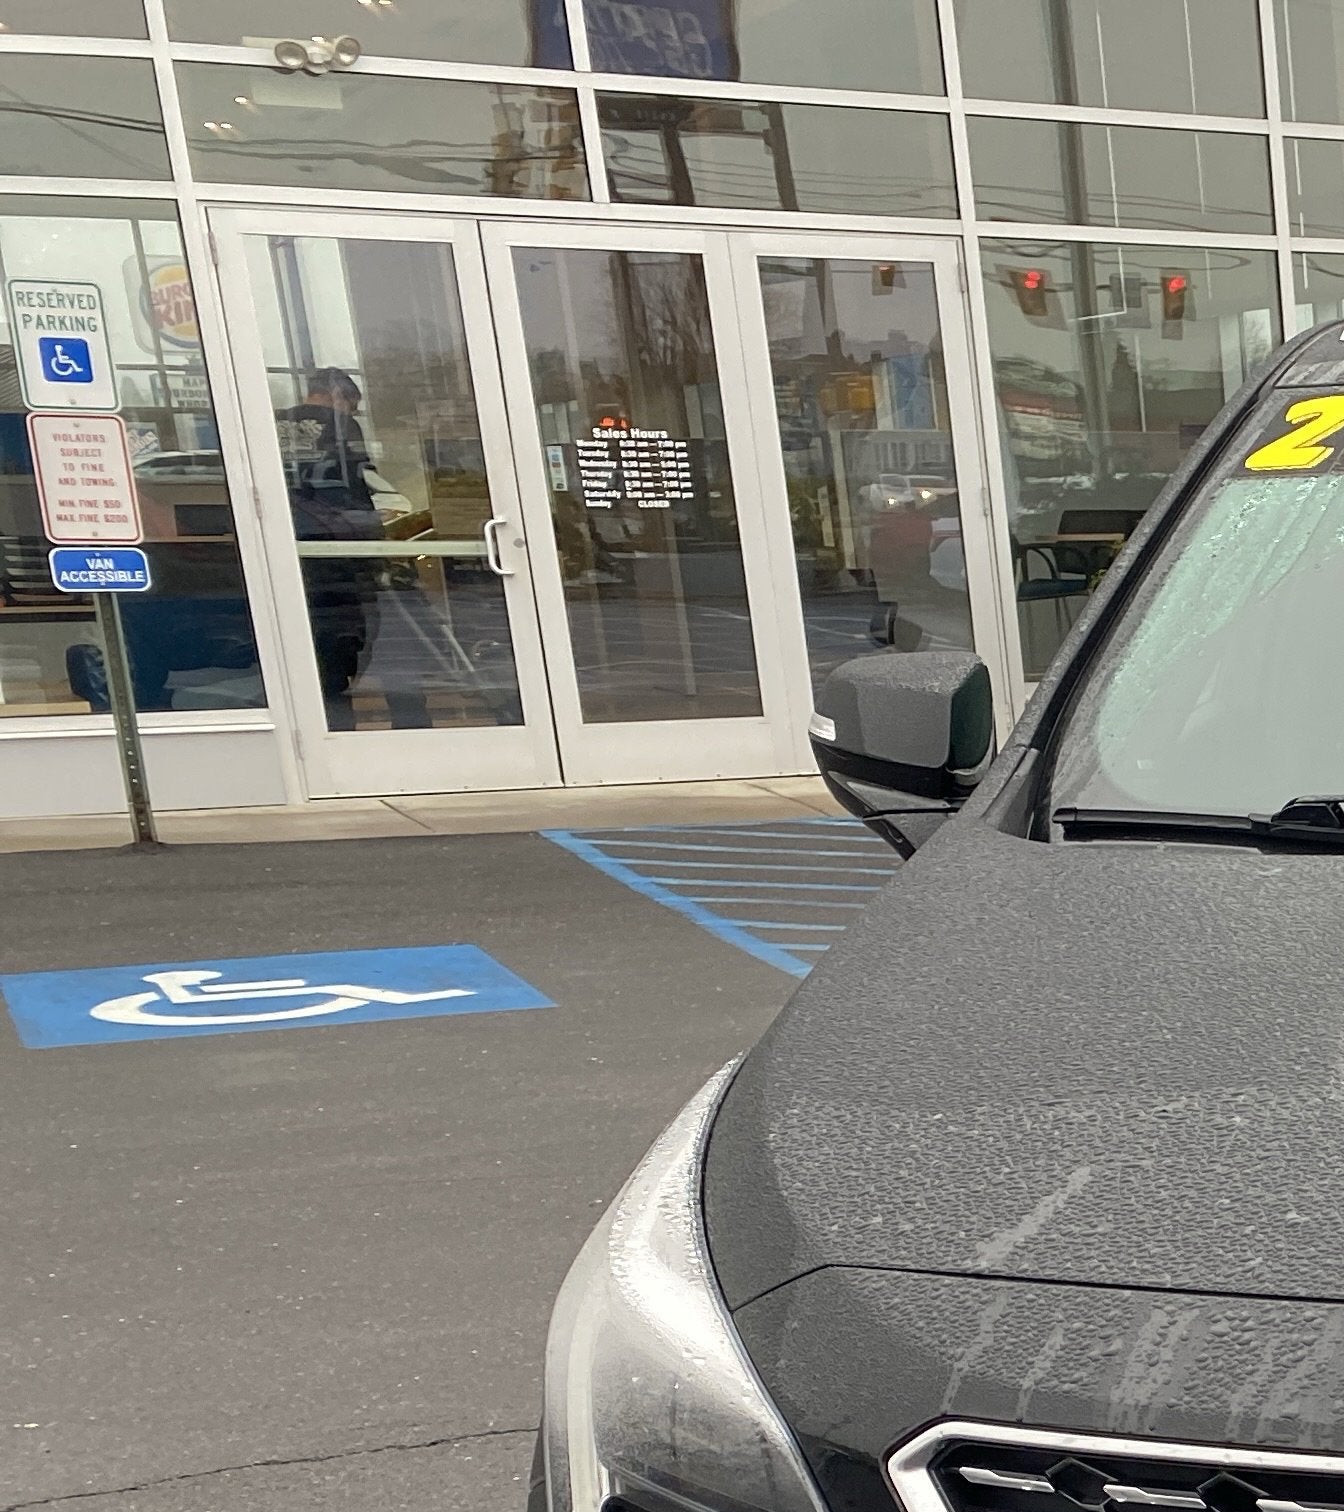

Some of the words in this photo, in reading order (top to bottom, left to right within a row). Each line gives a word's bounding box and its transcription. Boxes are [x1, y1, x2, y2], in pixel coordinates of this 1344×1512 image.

[15, 290, 97, 310] RESERVED
[22, 313, 98, 332] PARKING
[52, 432, 106, 443] VIOLATORS
[592, 427, 628, 439] Sales
[630, 428, 668, 439] Hours
[60, 448, 102, 458] SUBJECT
[63, 462, 75, 472] TO
[81, 462, 105, 473] FINE
[58, 477, 76, 486] AND
[79, 499, 99, 509] FINE
[85, 558, 114, 569] VAN
[60, 571, 146, 582] ACCESSIBLE
